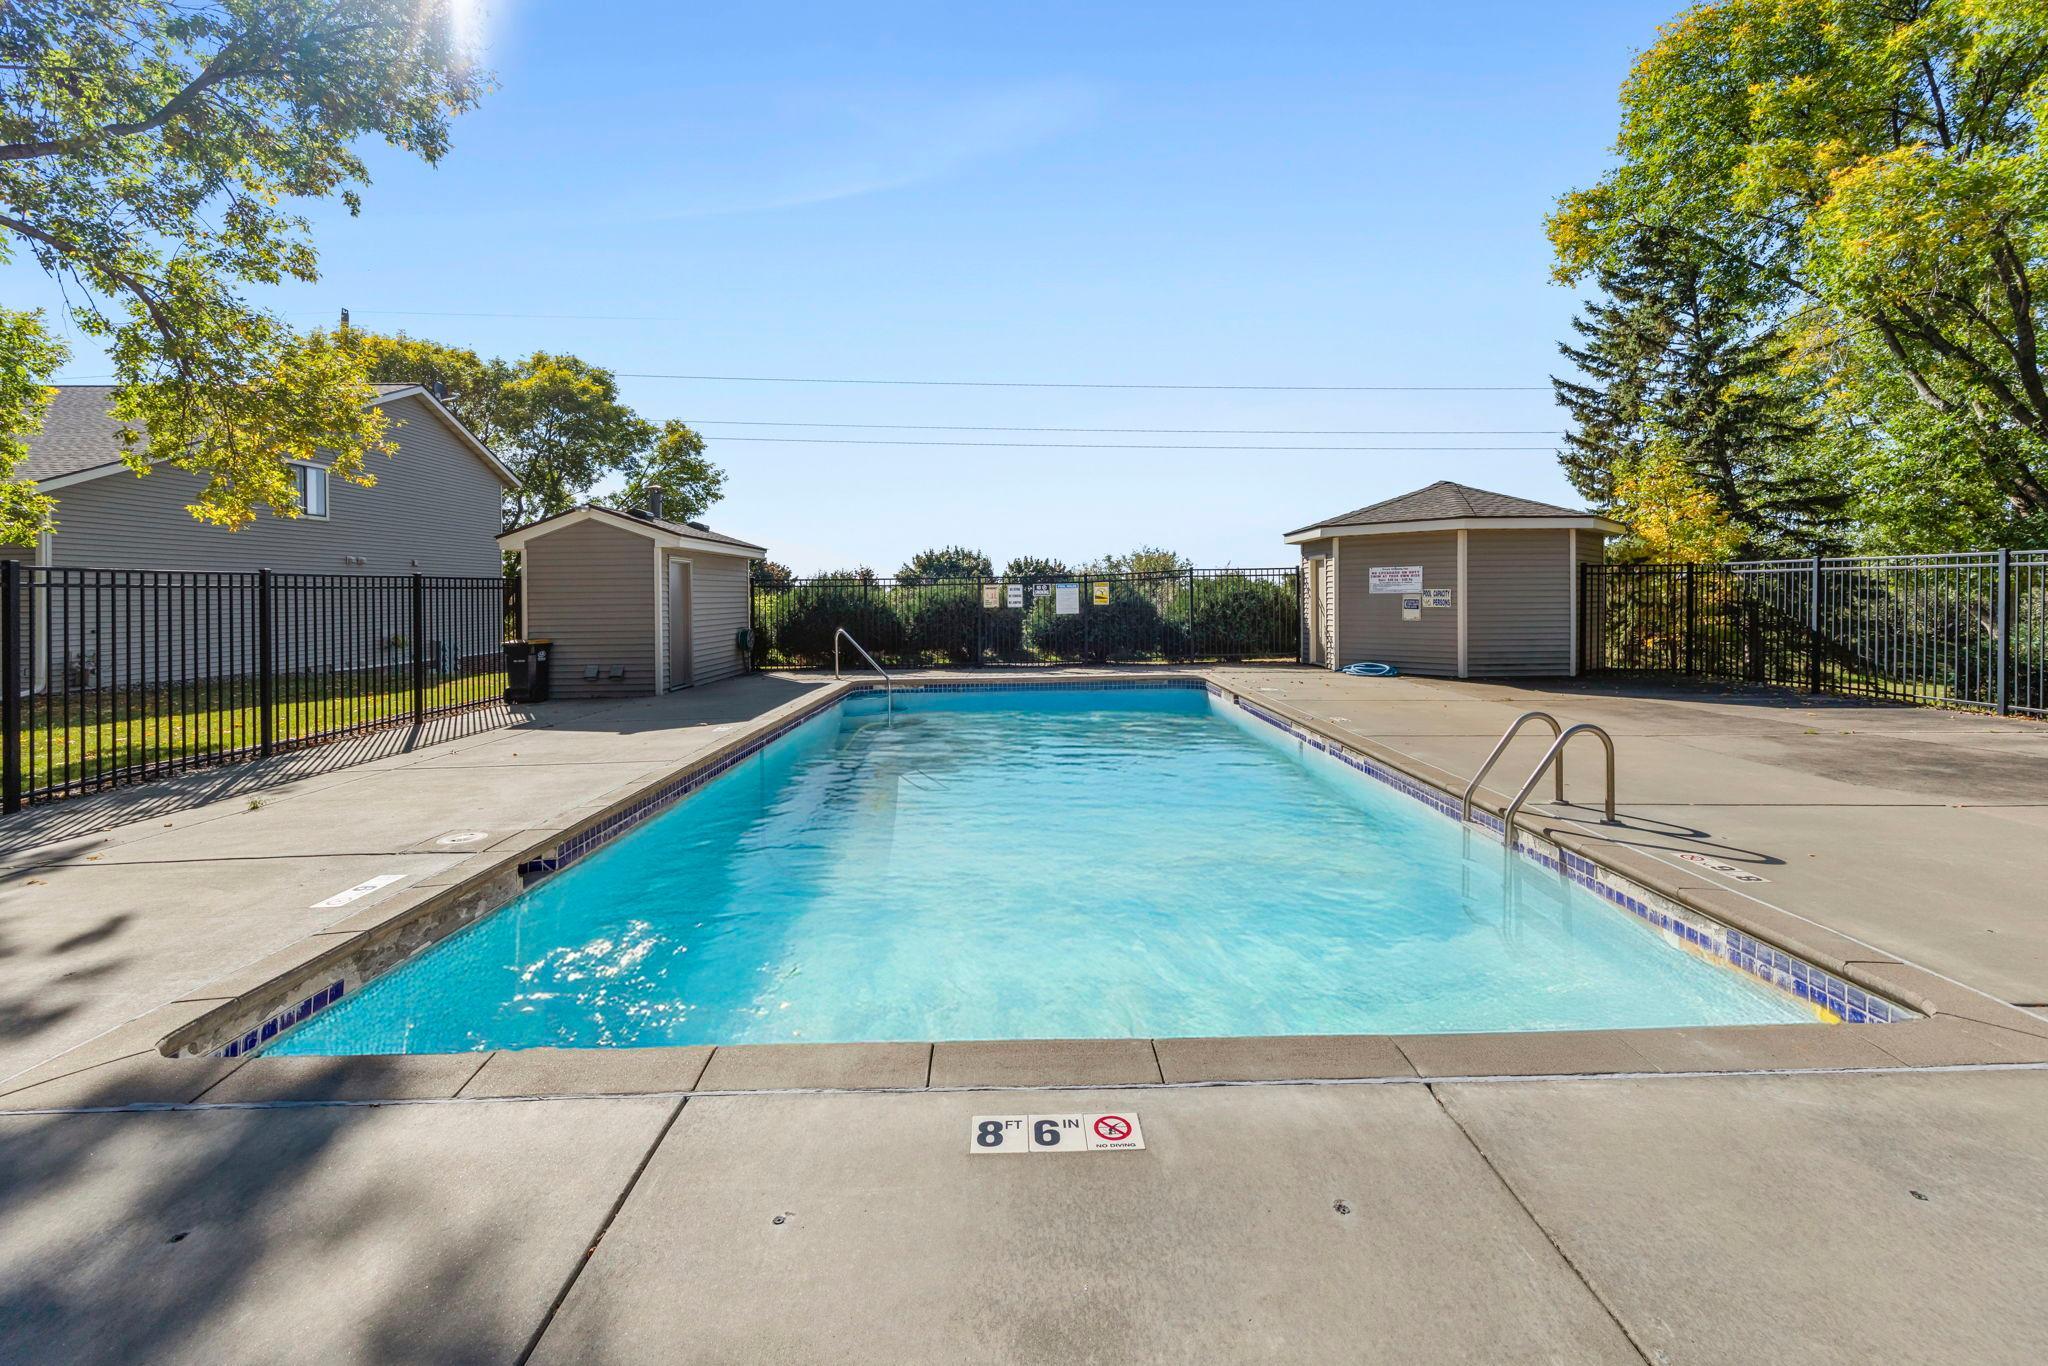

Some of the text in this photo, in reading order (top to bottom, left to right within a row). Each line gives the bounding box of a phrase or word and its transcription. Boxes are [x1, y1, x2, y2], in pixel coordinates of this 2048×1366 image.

[976, 1119, 1079, 1147] 8 FT 6 IN
